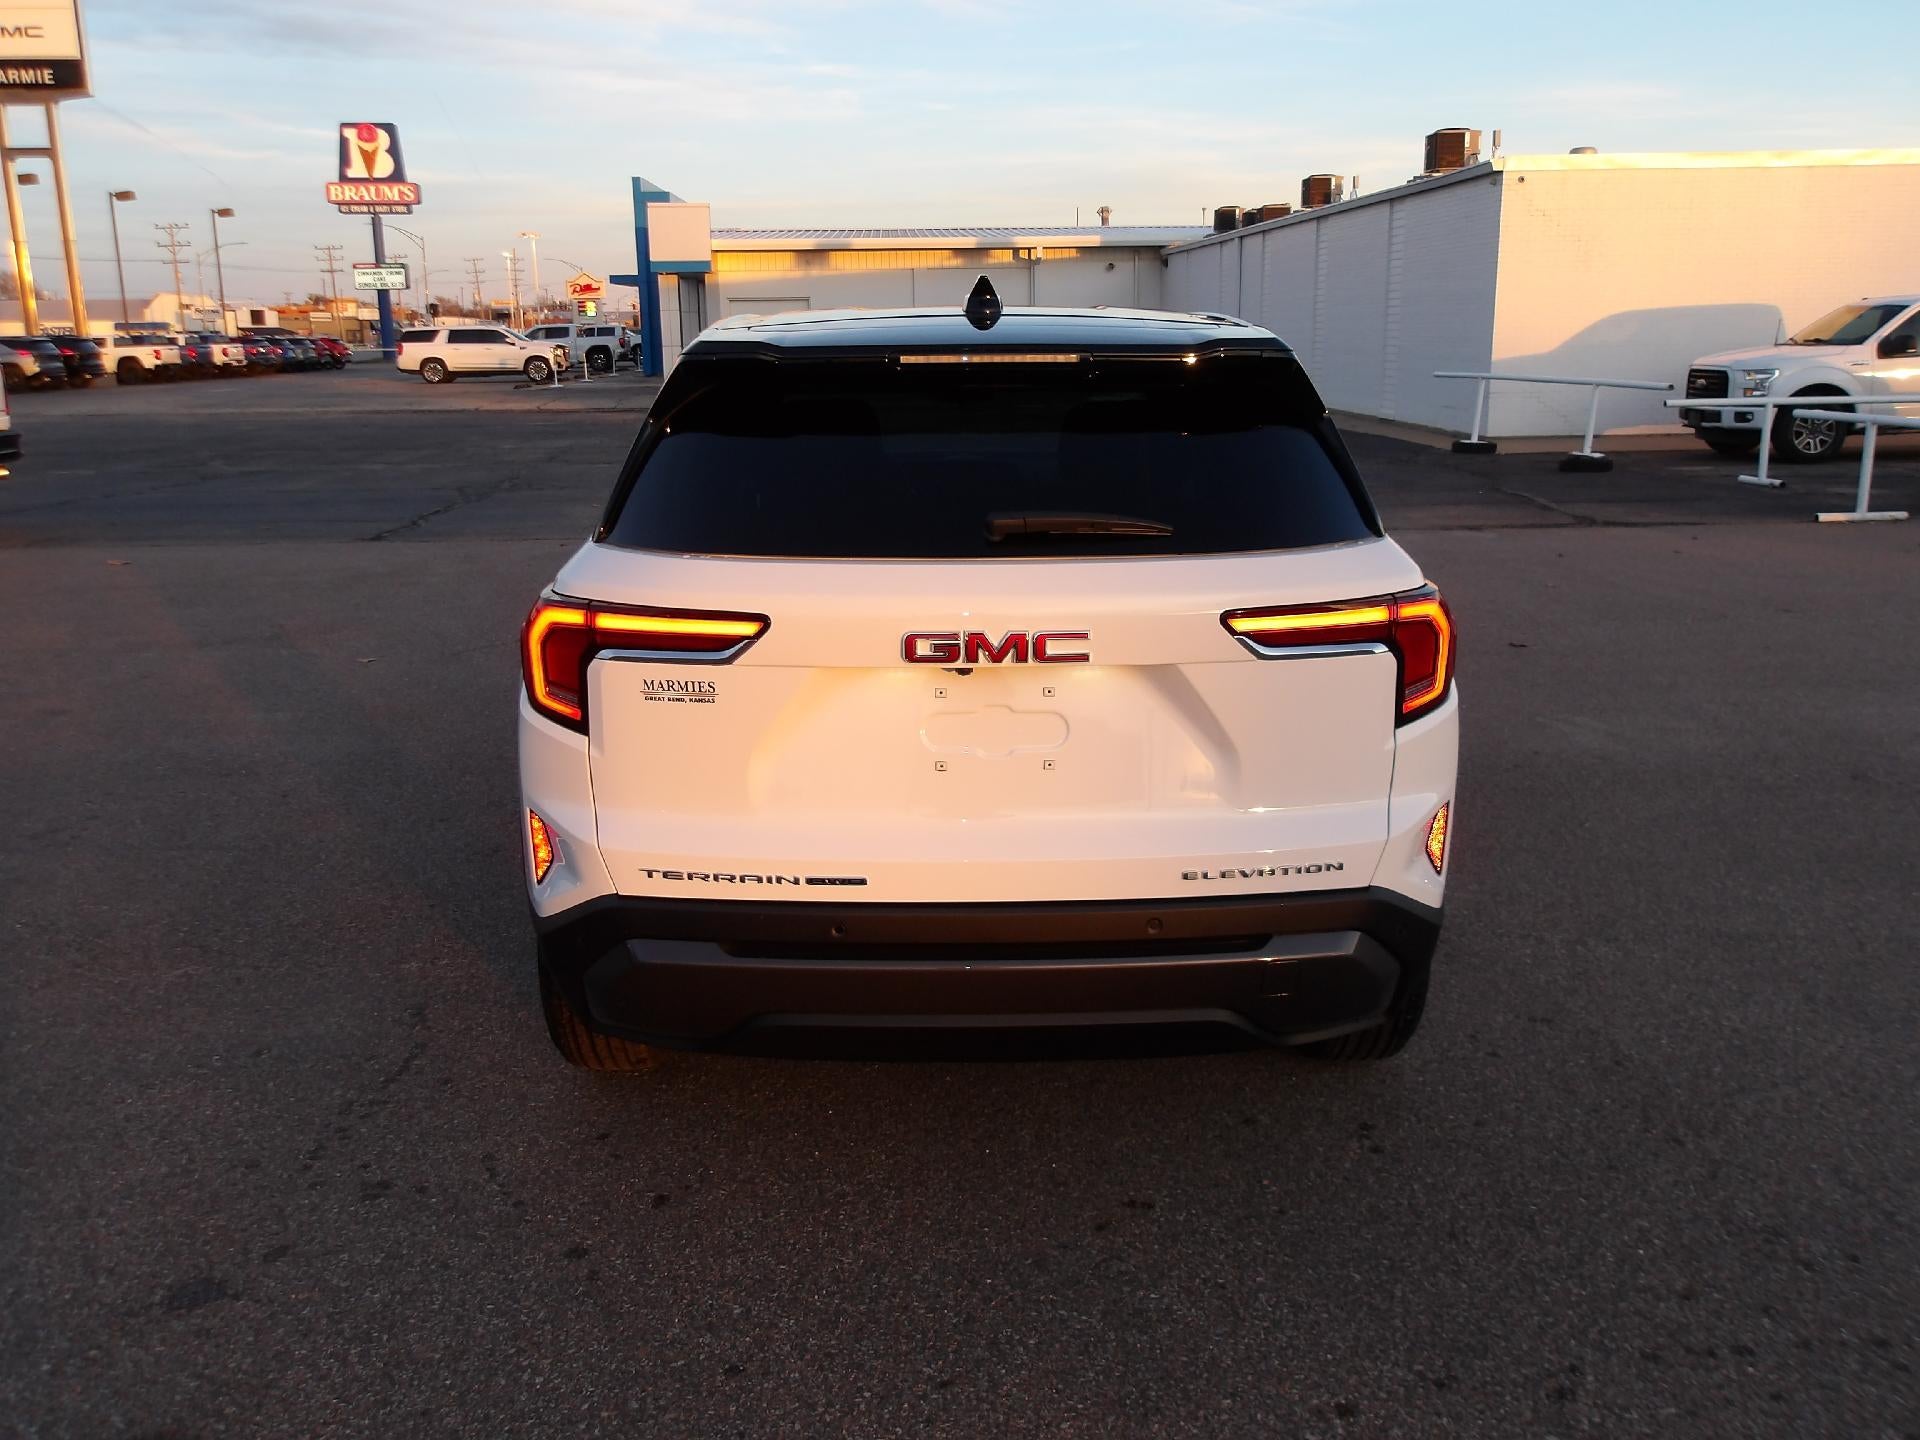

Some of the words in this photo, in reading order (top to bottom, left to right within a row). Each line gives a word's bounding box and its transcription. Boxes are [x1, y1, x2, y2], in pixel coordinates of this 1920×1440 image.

[329, 184, 415, 201] BRAUM'S
[901, 630, 1090, 663] GMC
[642, 679, 716, 694] MARMIES
[638, 868, 801, 886] TERRAIN
[1181, 861, 1345, 881] ELEVATION
